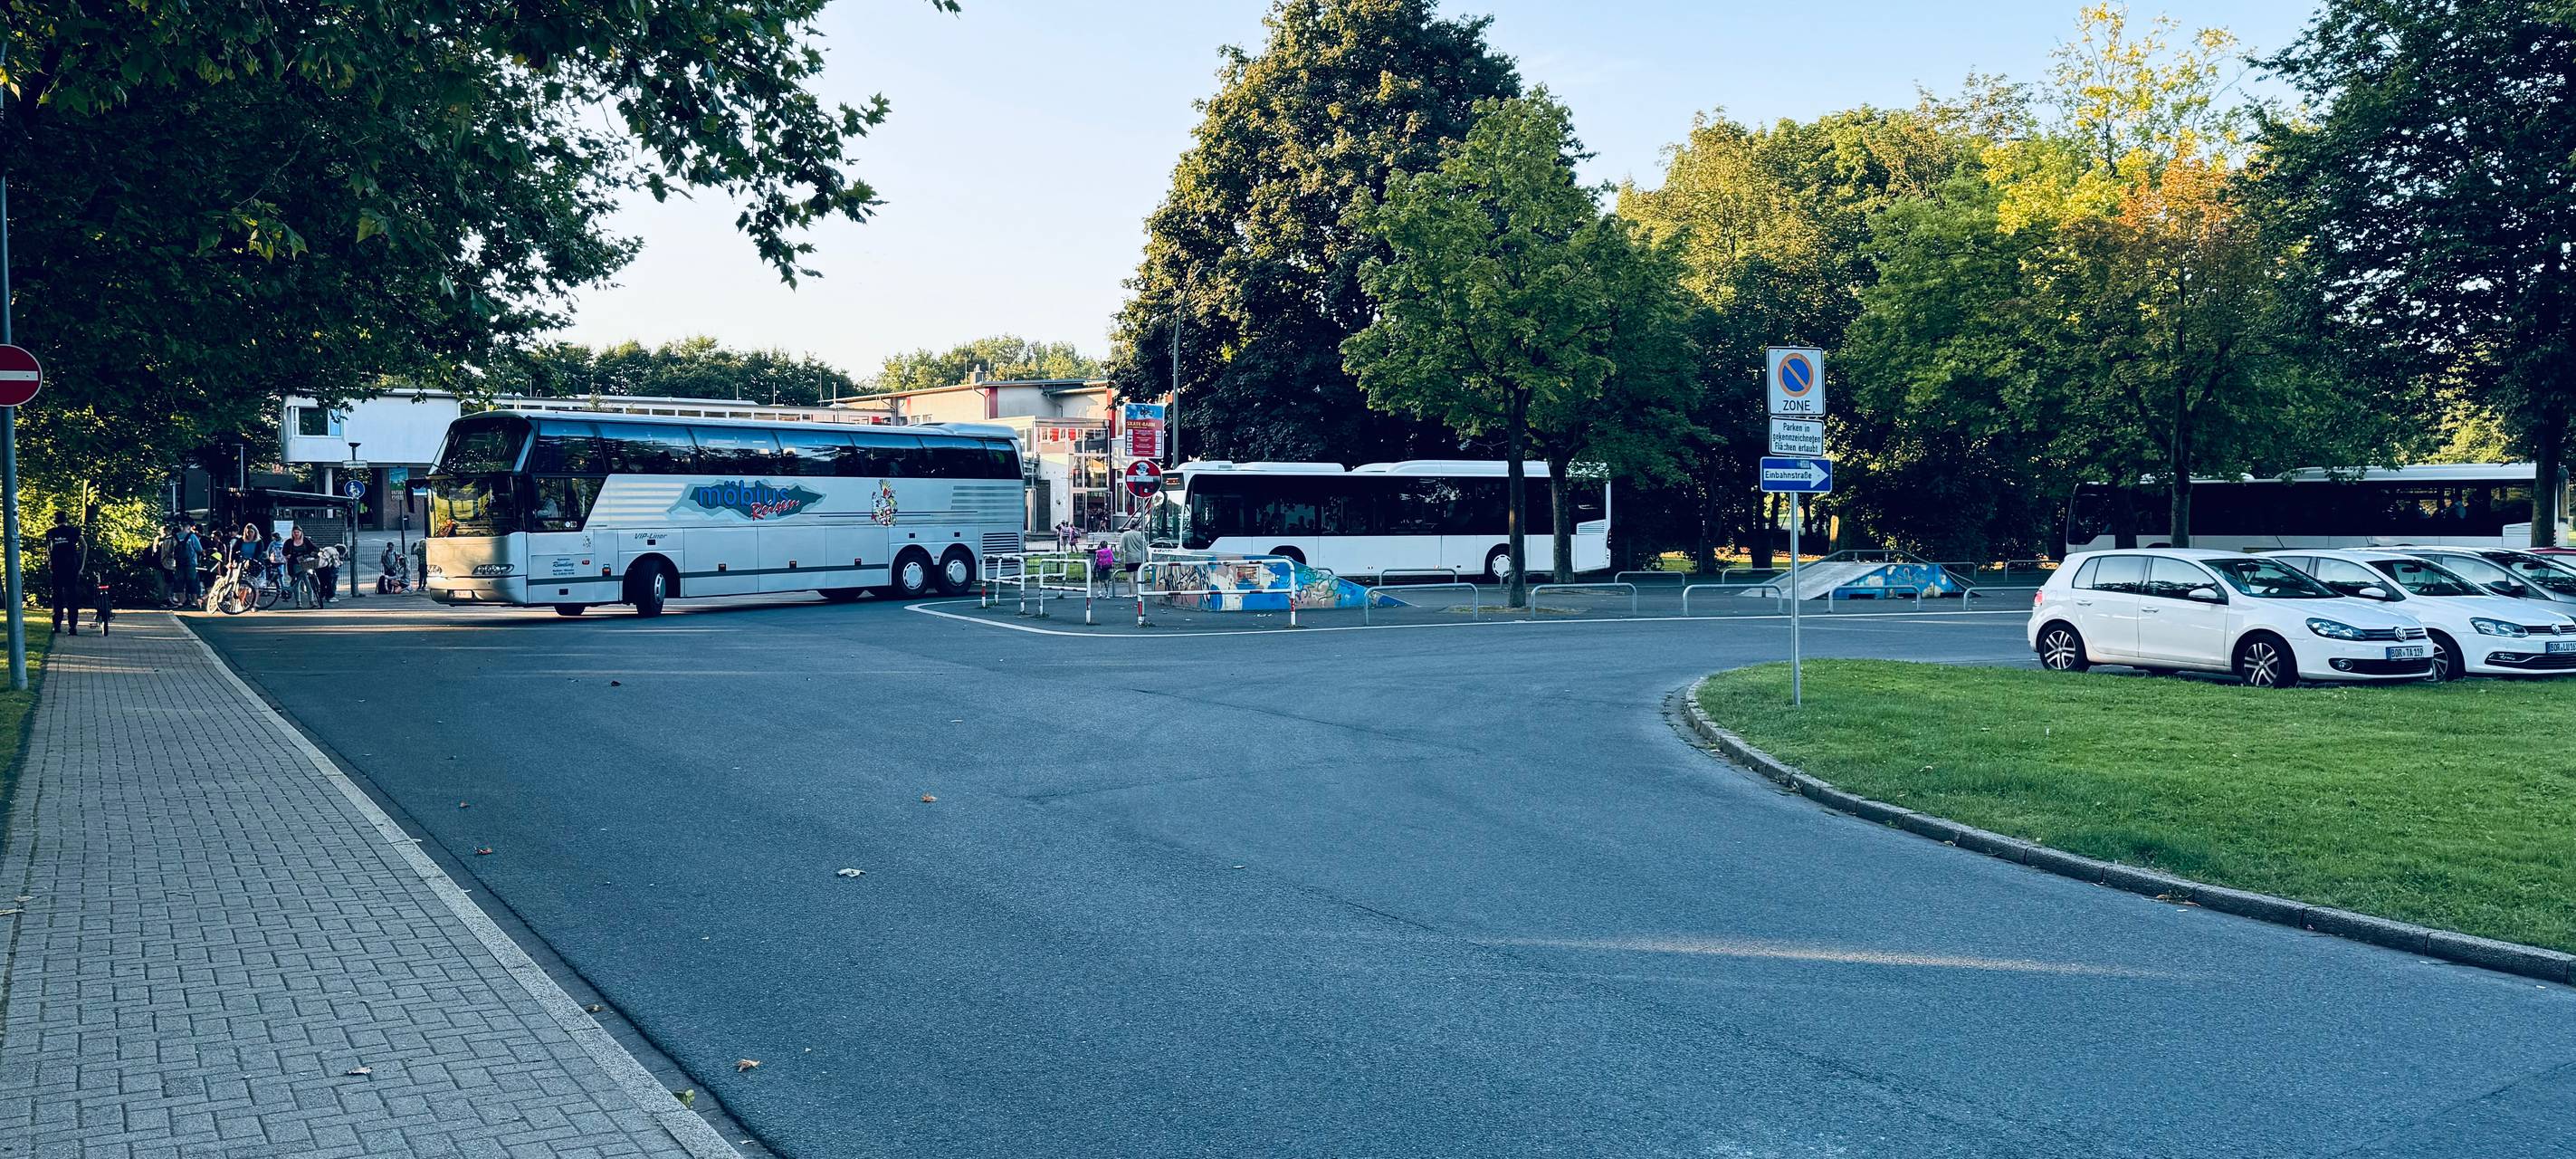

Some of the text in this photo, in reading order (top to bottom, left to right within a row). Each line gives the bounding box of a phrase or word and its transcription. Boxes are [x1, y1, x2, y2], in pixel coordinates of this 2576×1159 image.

[1782, 400, 1811, 411] ZONE
[1783, 422, 1810, 433] Parken in
[1798, 444, 1818, 453] erlaubt
[1765, 470, 1812, 479] Einbahnstraße
[698, 480, 790, 507] möbius
[750, 499, 800, 522] Reisen
